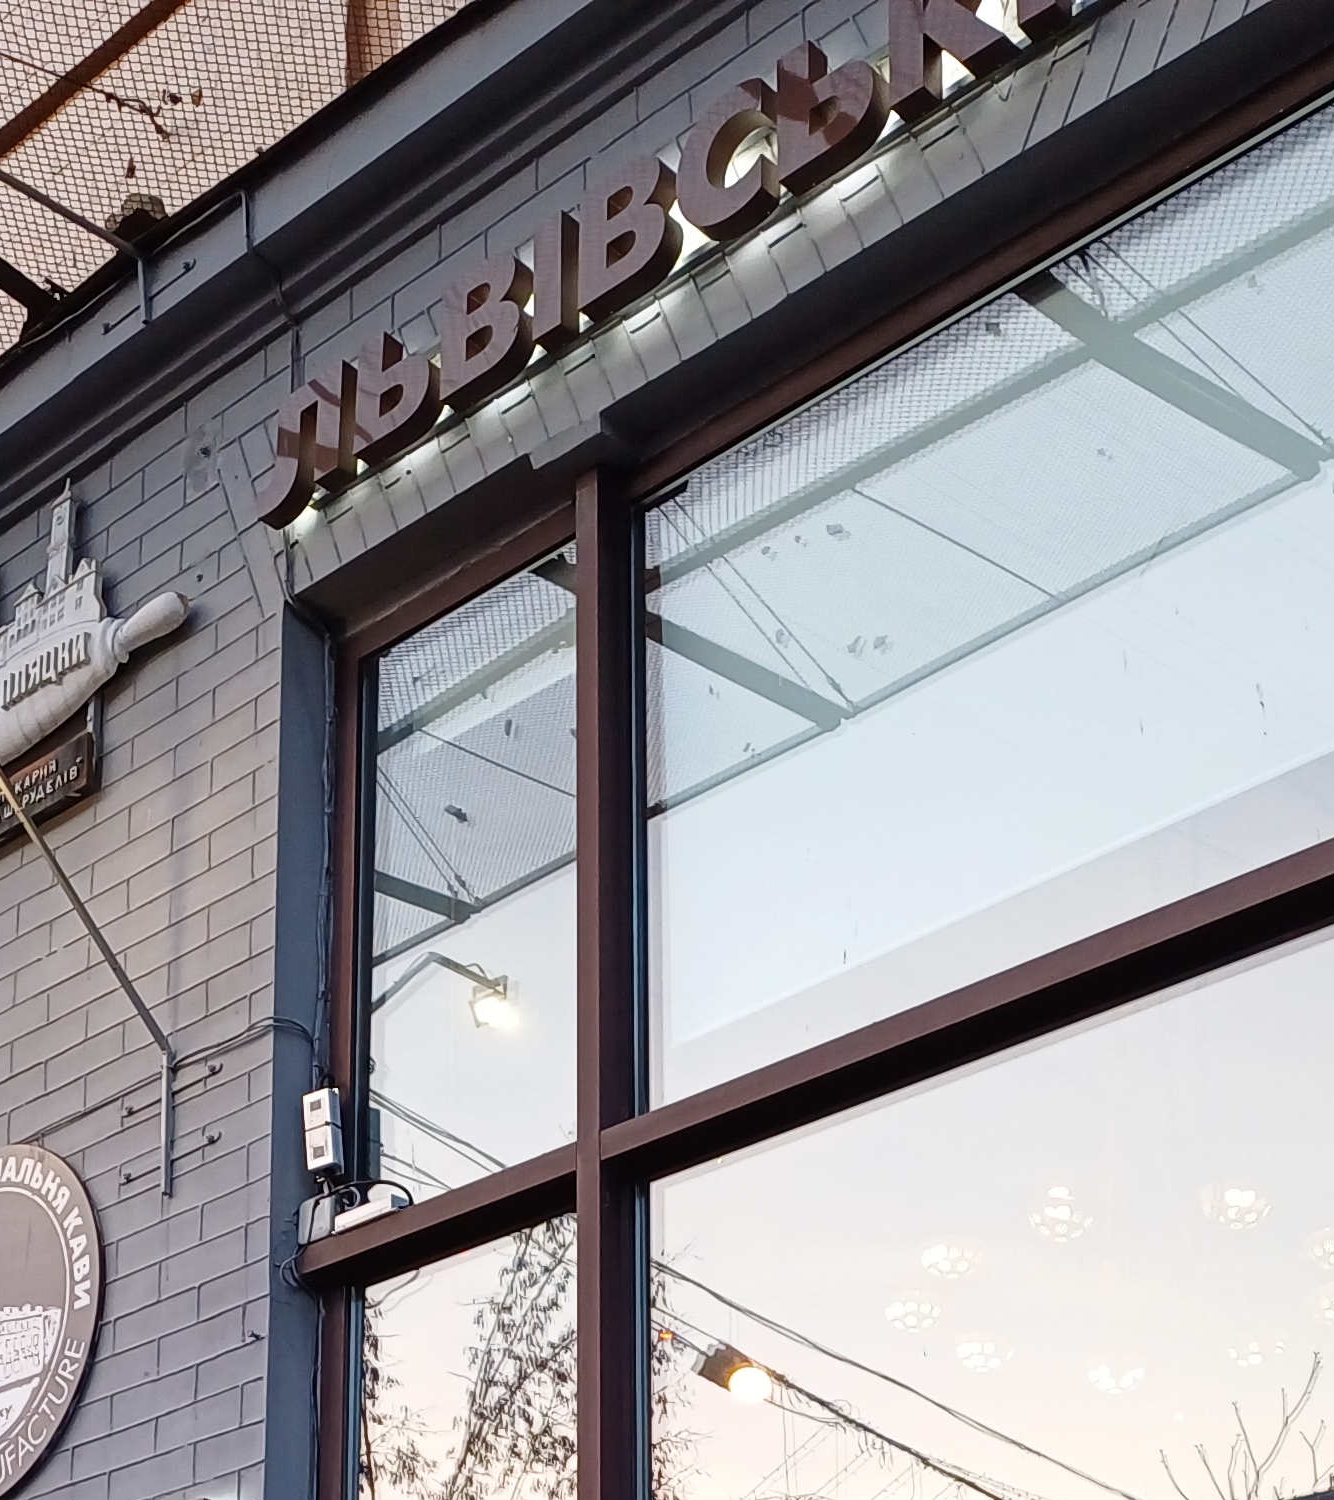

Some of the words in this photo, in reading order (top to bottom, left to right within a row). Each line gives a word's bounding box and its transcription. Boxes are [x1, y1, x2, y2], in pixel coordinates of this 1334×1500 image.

[259, 0, 1072, 528] ЛЬВІВСЬК
[0, 631, 92, 712] ПЛЯЦКИ
[3, 765, 78, 819] ШРУДЕЛІВ
[63, 1205, 91, 1310] КАВИ
